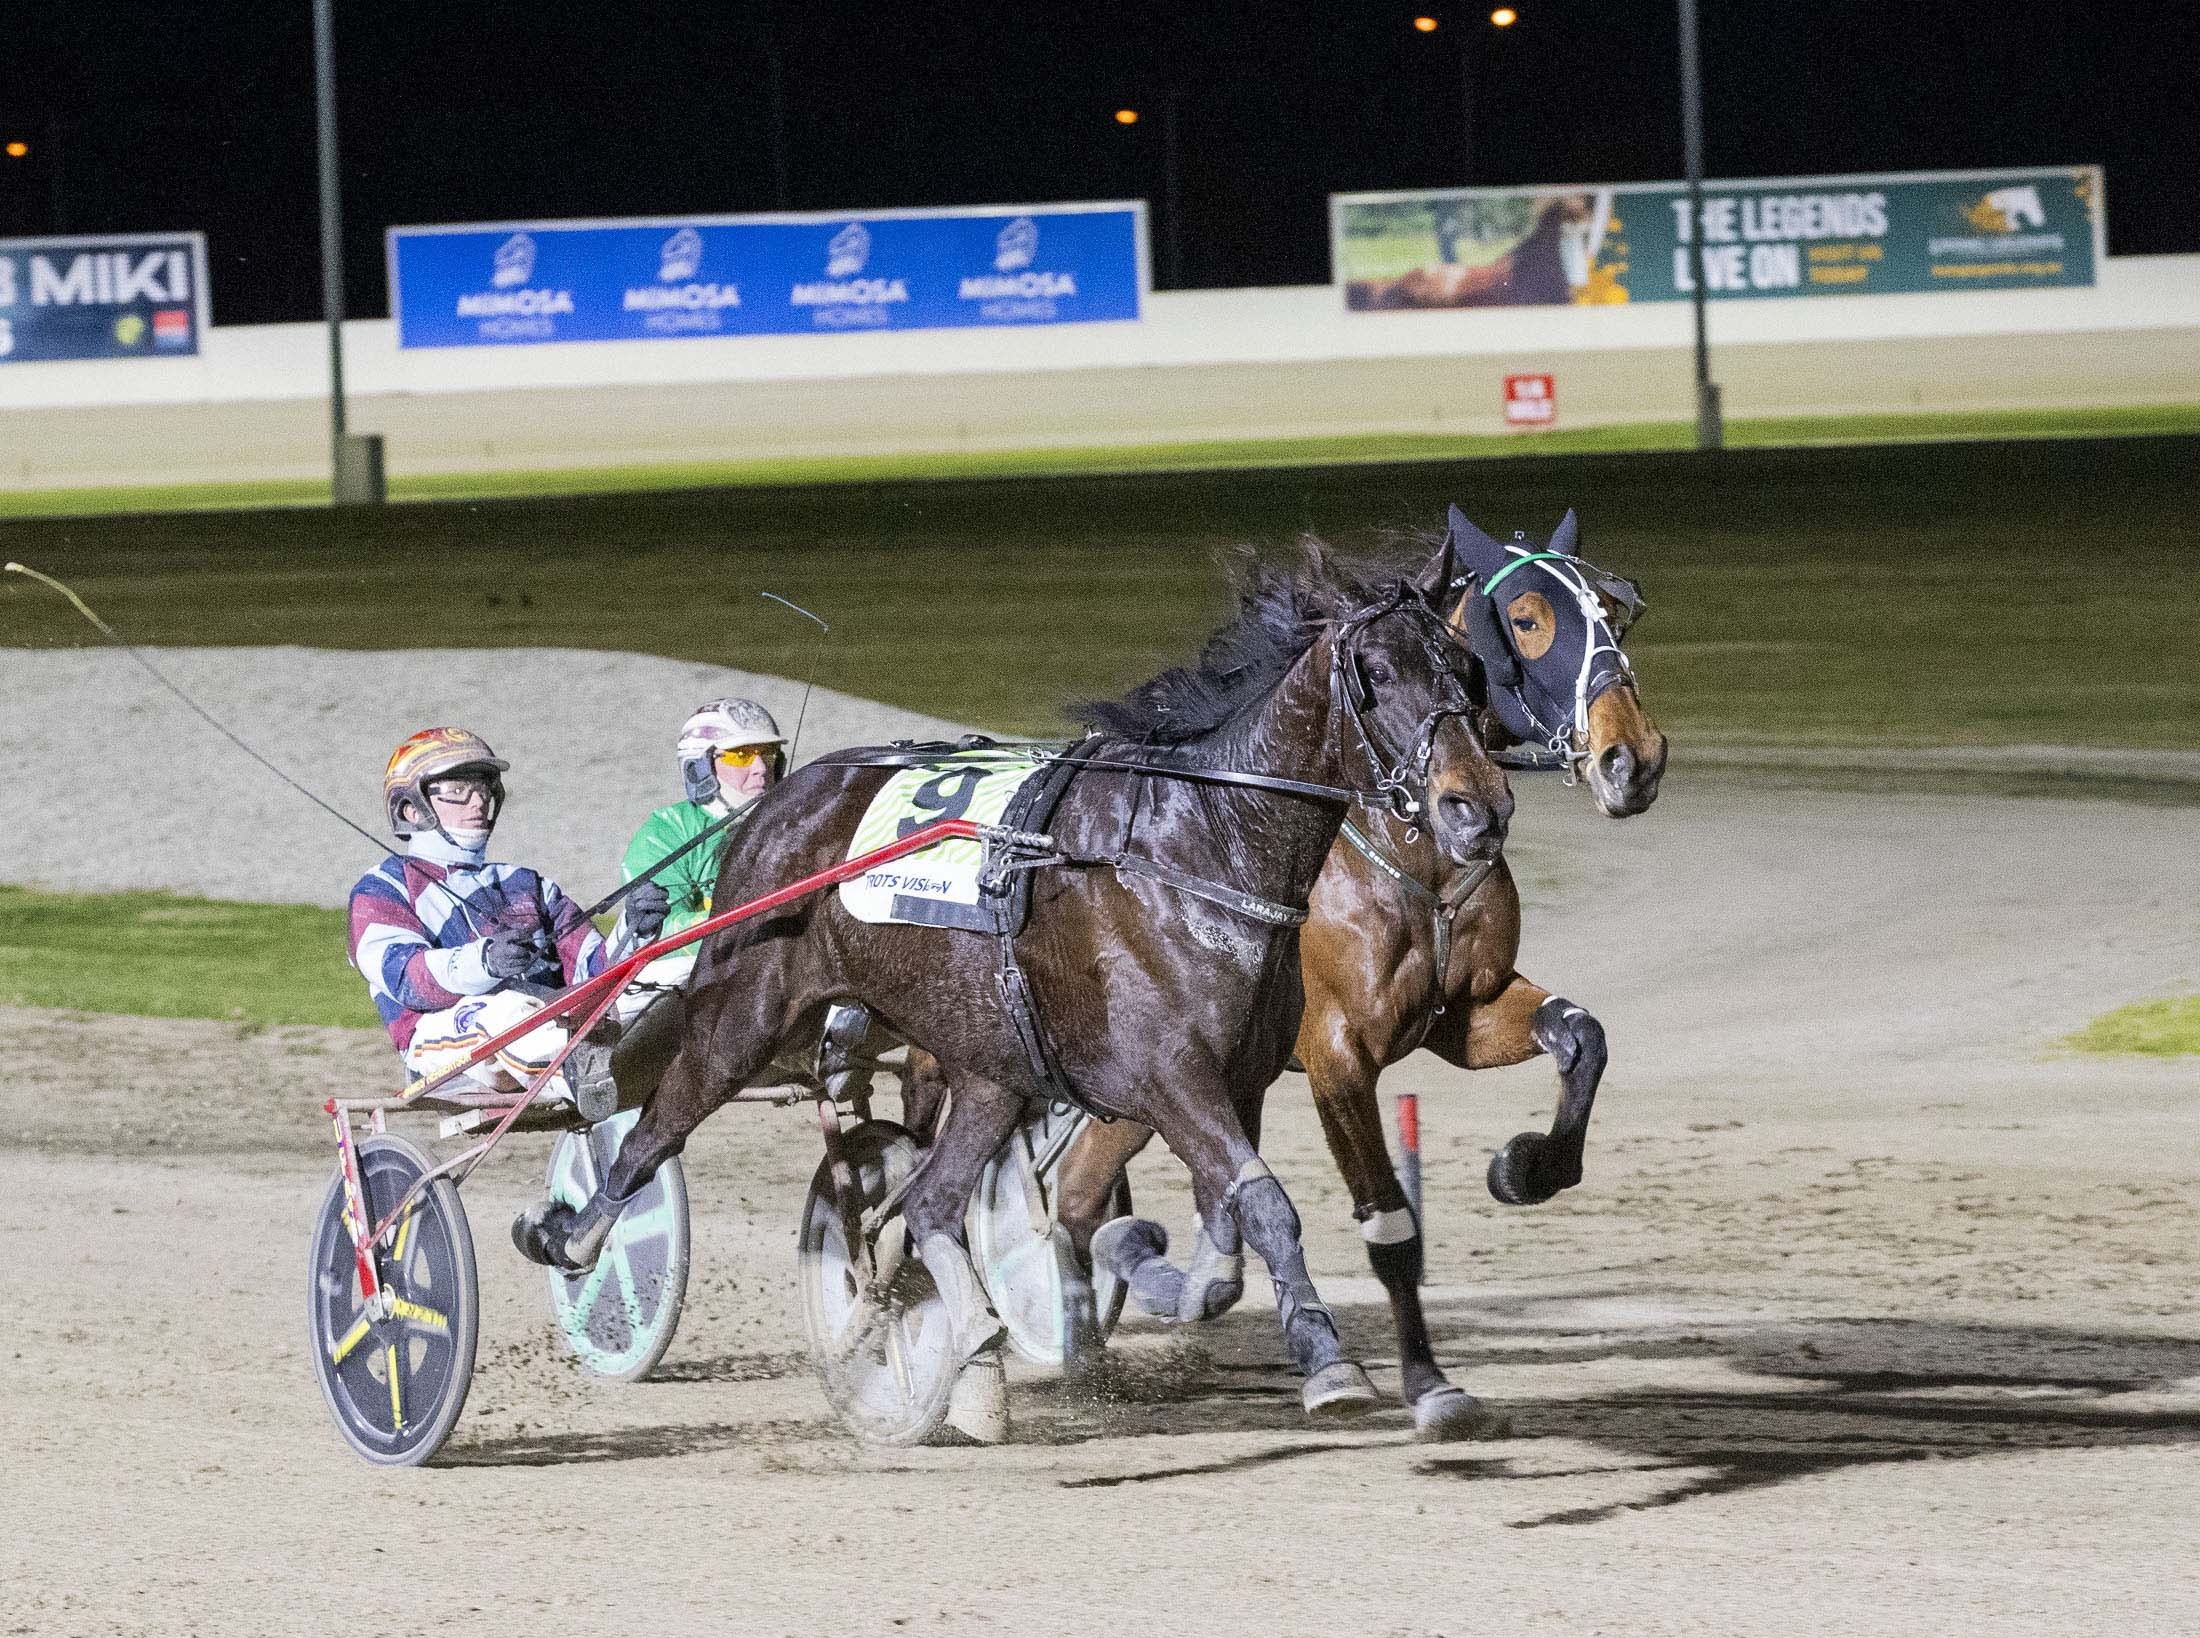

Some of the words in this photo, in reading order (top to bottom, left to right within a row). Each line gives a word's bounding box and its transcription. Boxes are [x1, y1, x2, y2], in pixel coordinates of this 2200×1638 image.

[1672, 198, 1738, 242] THE
[1742, 193, 1888, 240] LEGENDS
[31, 251, 189, 304] MIKI
[958, 272, 1077, 300] MIMOSA
[1673, 246, 1748, 291] LVE
[1750, 245, 1799, 288] ON
[457, 288, 574, 317] MIMOSA
[623, 283, 741, 312] MIMOSA
[791, 278, 908, 305] MIMOSA
[896, 766, 993, 840] 9
